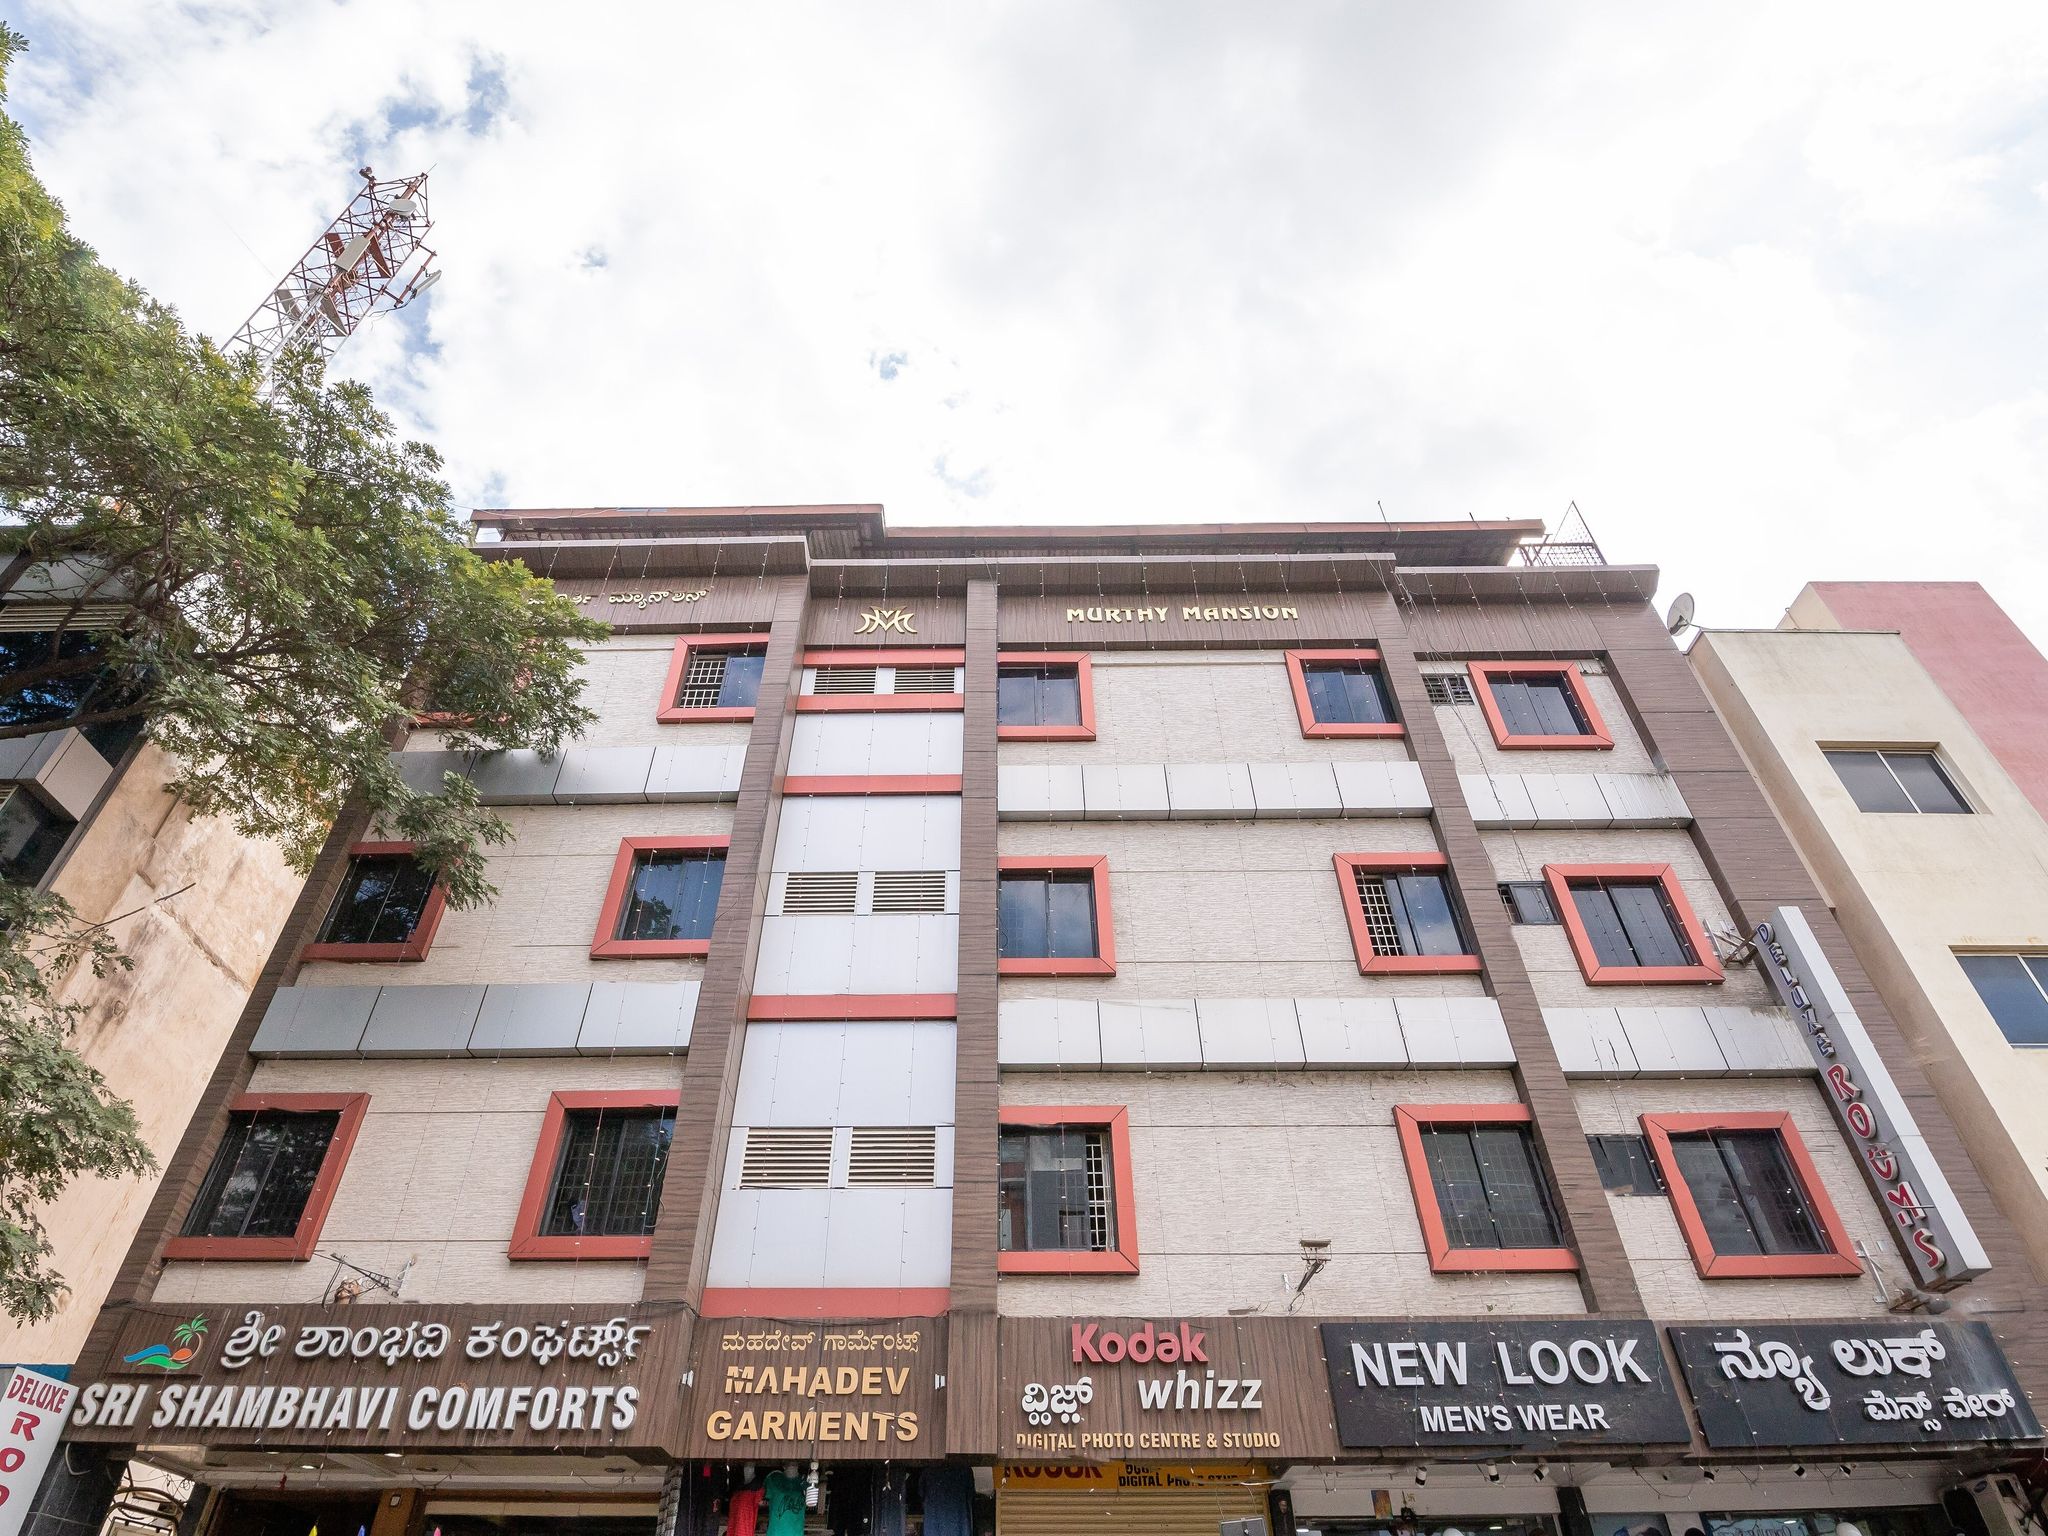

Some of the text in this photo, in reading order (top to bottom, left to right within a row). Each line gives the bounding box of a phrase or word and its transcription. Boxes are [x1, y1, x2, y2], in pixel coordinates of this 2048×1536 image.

[1066, 606, 1298, 622] MURTHY MANSION
[1756, 922, 1835, 1058] DELUXE
[1827, 1063, 1946, 1271] ROOMS
[220, 1310, 286, 1369] ಶ್ರೀ
[295, 1320, 451, 1366] ಶಾಂಭವಿ
[721, 1329, 816, 1351] ಮಹದೇವ್
[1072, 1322, 1208, 1363] Kodak
[1832, 1329, 1946, 1378] ಲುಕ್
[724, 1366, 910, 1397] MAHADEV
[1351, 1339, 1652, 1387] NEW LOOK
[7, 1374, 69, 1414] DELUXE
[72, 1383, 639, 1431] SRI SHAMBHAVI COMFORTS
[1138, 1370, 1263, 1410] whizz
[1942, 1387, 2016, 1419] ವೇರ್
[706, 1410, 919, 1441] GARMENTS
[1516, 1404, 1611, 1431] WEAR
[1016, 1432, 1280, 1451] DIGITAL PHOTO CENTRE & STUDIO
[1119, 1472, 1163, 1487] DIGITAL
